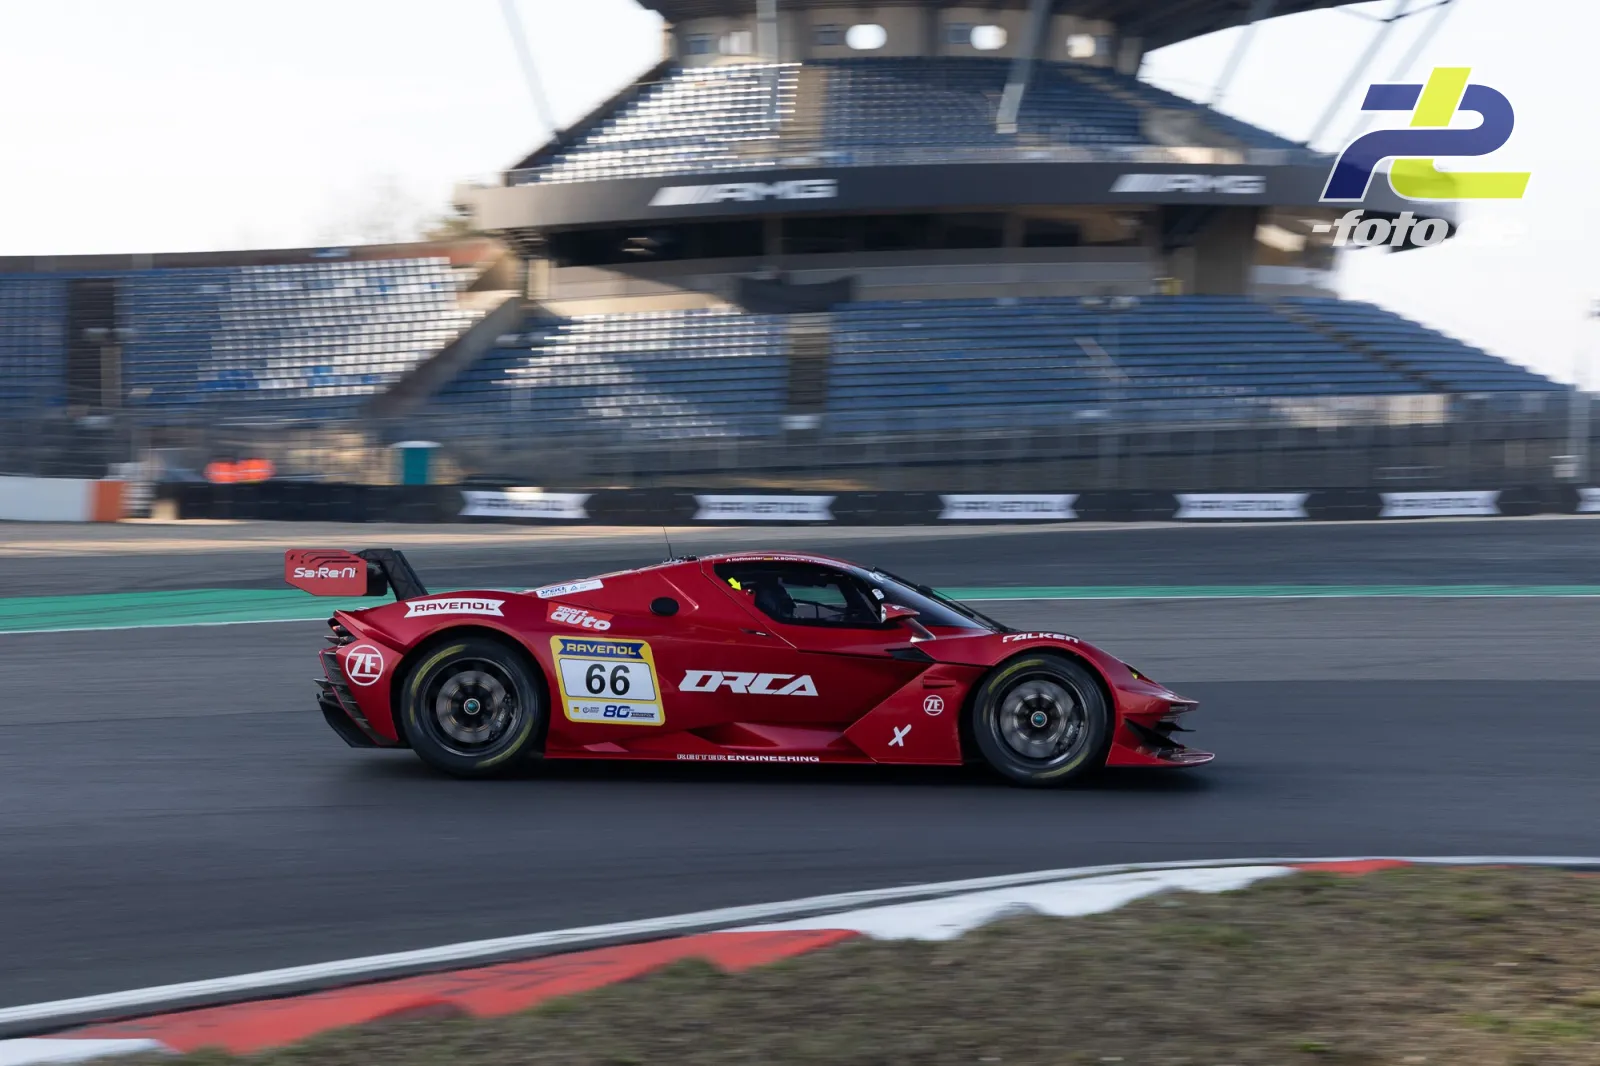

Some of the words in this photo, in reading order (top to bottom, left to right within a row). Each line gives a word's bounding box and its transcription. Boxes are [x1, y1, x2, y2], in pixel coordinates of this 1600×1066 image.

[413, 601, 495, 613] RAVENOL
[556, 605, 589, 617] sport
[550, 610, 611, 631] auto
[1002, 632, 1079, 644] FALKEN
[566, 643, 637, 656] RAVENOL
[350, 652, 377, 676] ZF
[585, 664, 631, 696] 66
[678, 669, 819, 696] ORCA
[603, 705, 630, 718] 80
[727, 754, 820, 762] ENGINEERING
